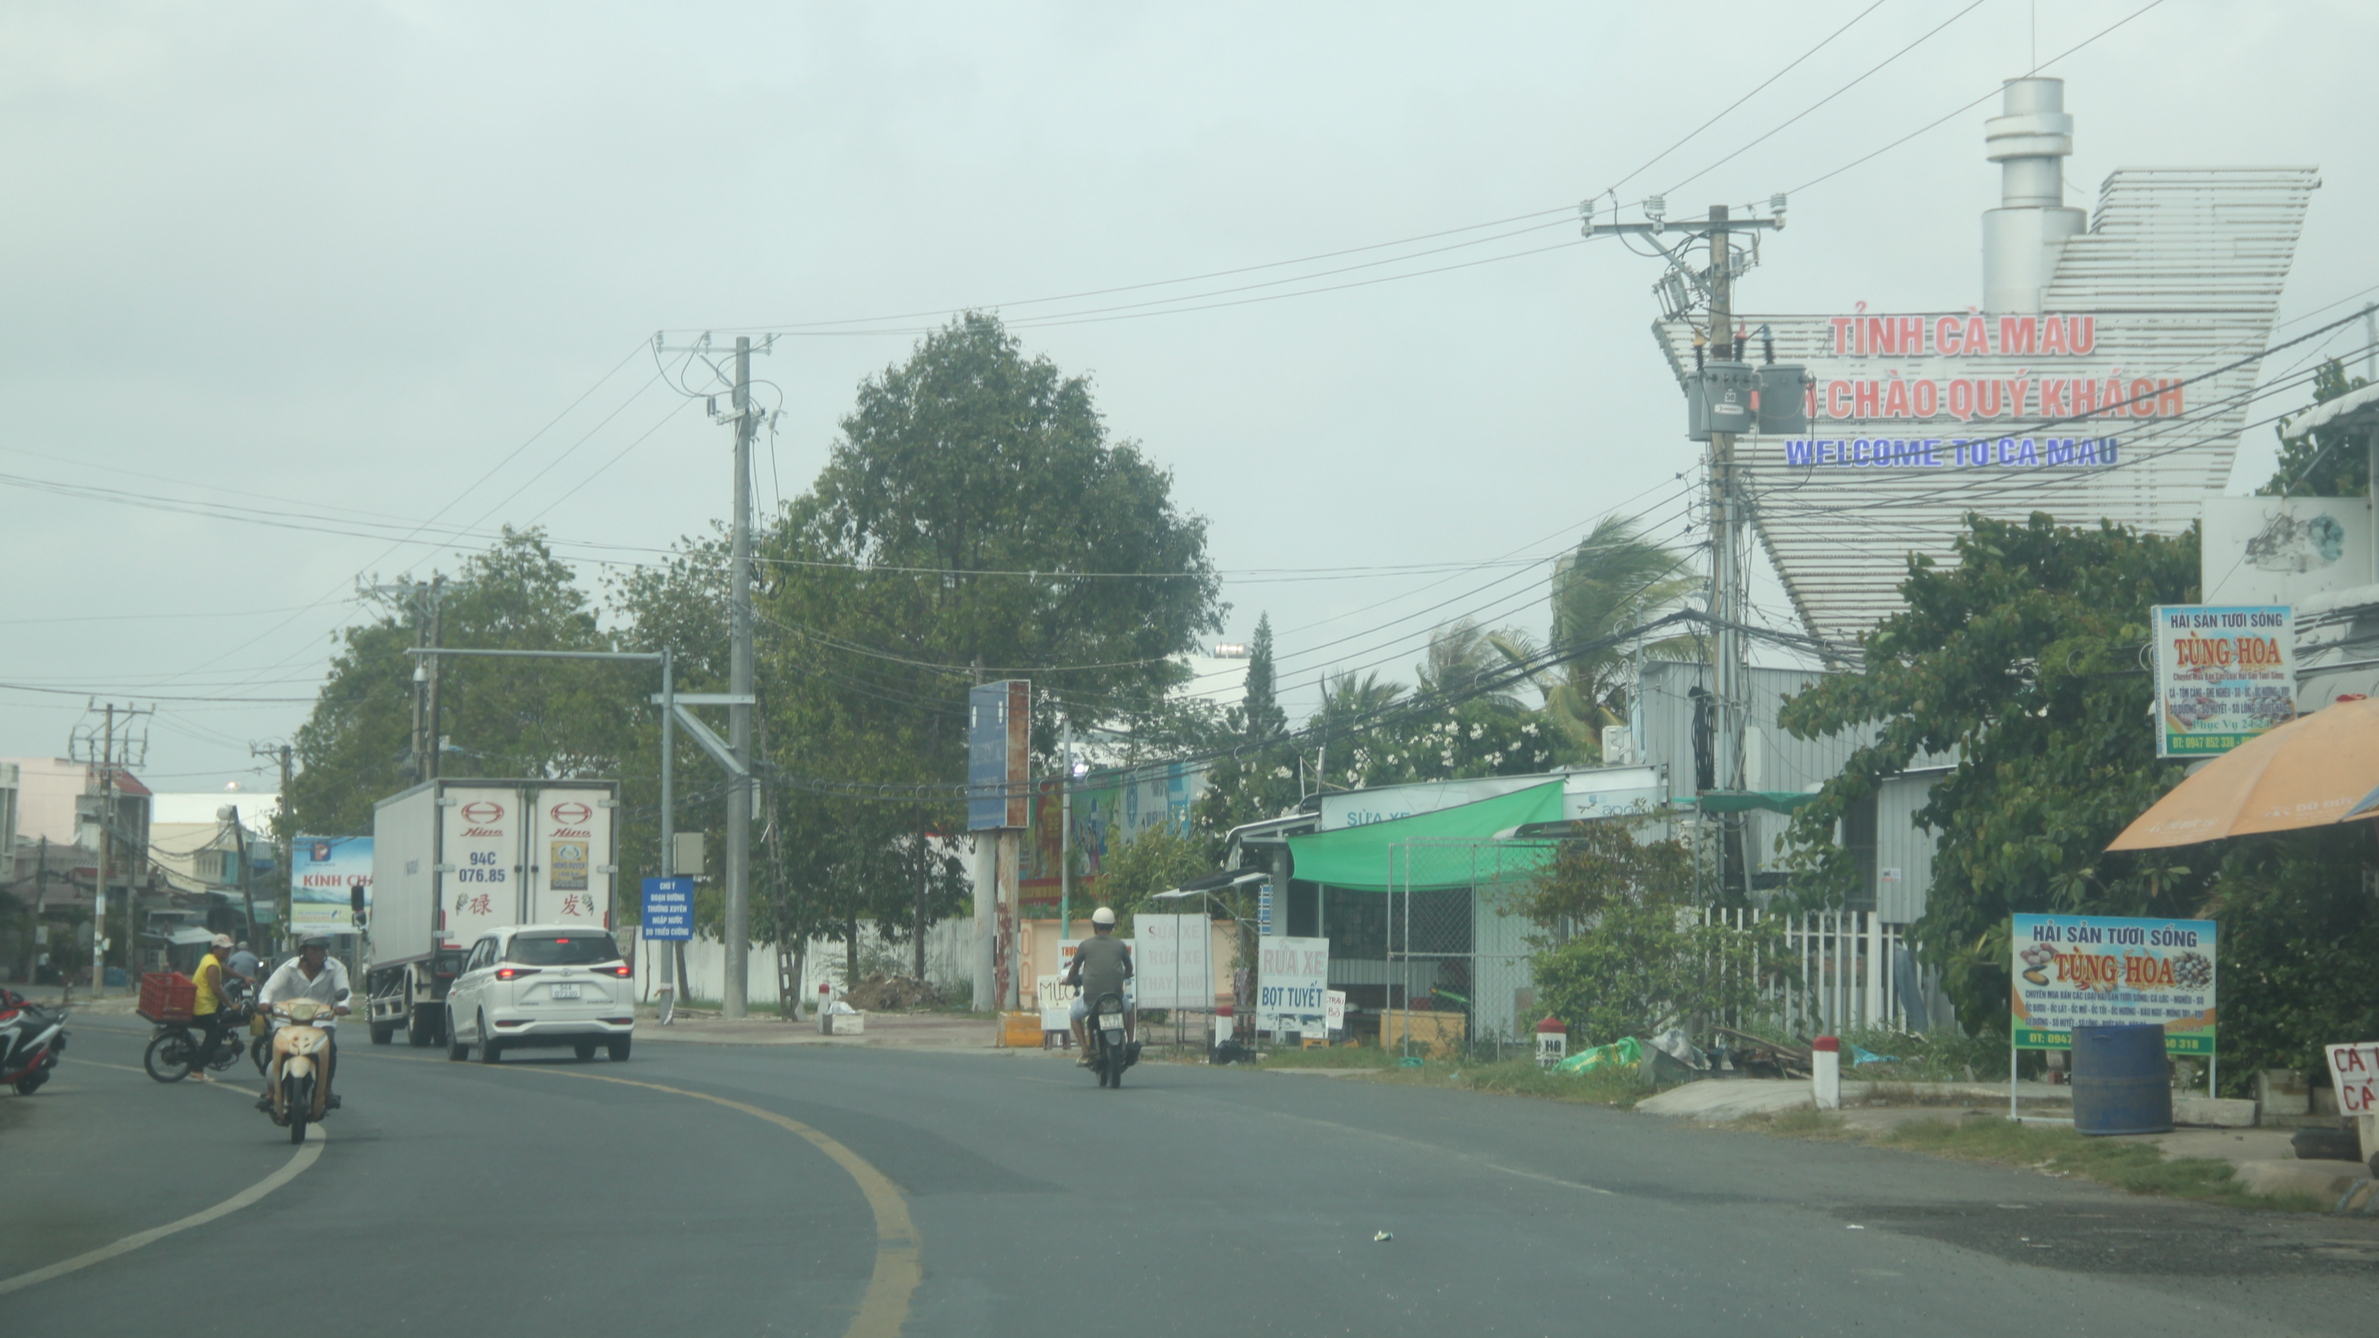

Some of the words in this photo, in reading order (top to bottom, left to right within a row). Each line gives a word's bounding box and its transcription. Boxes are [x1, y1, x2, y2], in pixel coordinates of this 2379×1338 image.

[1829, 301, 1926, 355] TỈNH
[1934, 305, 1991, 355] CÀ
[2000, 315, 2096, 355] MAU
[1826, 369, 1939, 419] CHÀO
[1947, 369, 2033, 421] QUÝ
[2040, 367, 2185, 418] KHÁCH
[1786, 439, 1944, 468] WELCOME
[1953, 438, 1990, 467] TO
[1998, 438, 2038, 467] CA
[2047, 437, 2119, 467] MAU
[2171, 609, 2190, 629] HẢI
[2194, 609, 2218, 628] SẢN
[2221, 612, 2246, 628] TƯƠI
[2251, 608, 2283, 627] SỐNG
[2174, 631, 2231, 668] TÙNG
[470, 851, 496, 866] 94C
[304, 872, 342, 887] KÍNH
[459, 868, 505, 882] 076.85
[468, 893, 493, 916] 禄
[560, 894, 582, 917] 发
[1181, 924, 1201, 939] XE
[2033, 919, 2062, 943] HẢI
[2067, 920, 2102, 943] SẢN
[2107, 927, 2145, 945] TƯƠI
[2151, 923, 2198, 948] SỐNG
[1183, 950, 1202, 965] XE
[1263, 940, 1299, 976] RỬA
[1303, 951, 1326, 978] XE
[2054, 946, 2118, 983] TÙNG
[1262, 986, 1284, 1011] BỌT
[1288, 980, 1323, 1008] TUYẾT
[2030, 1033, 2044, 1043] ĐT:
[2179, 1039, 2199, 1049] 318
